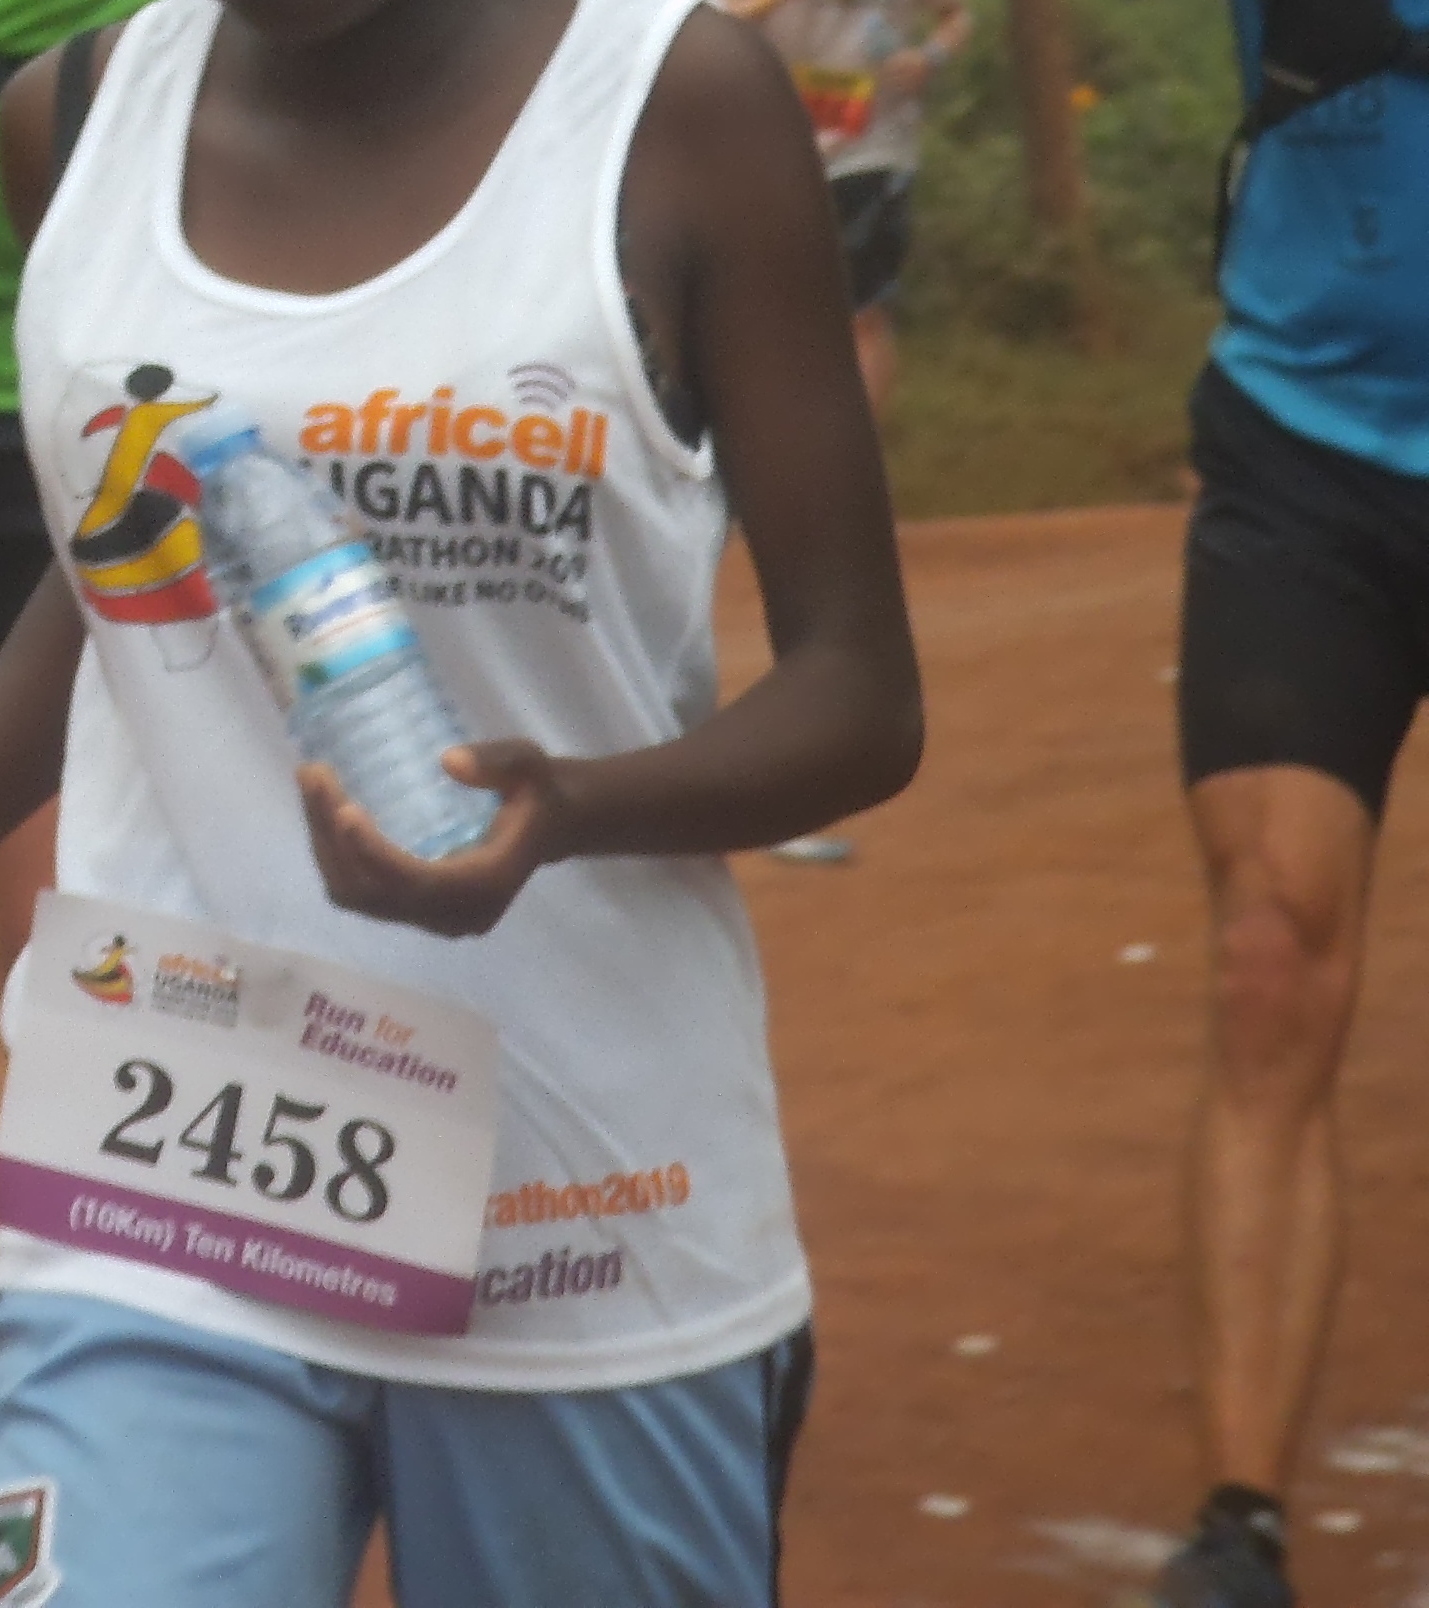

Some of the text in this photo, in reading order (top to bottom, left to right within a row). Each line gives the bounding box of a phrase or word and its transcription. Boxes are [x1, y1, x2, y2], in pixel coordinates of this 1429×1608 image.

[299, 387, 608, 479] africell
[299, 1022, 458, 1094] Education
[304, 991, 366, 1034] Run
[98, 1058, 396, 1225] 2458
[69, 1194, 398, 1307] (10Km) Ten Kilometres
